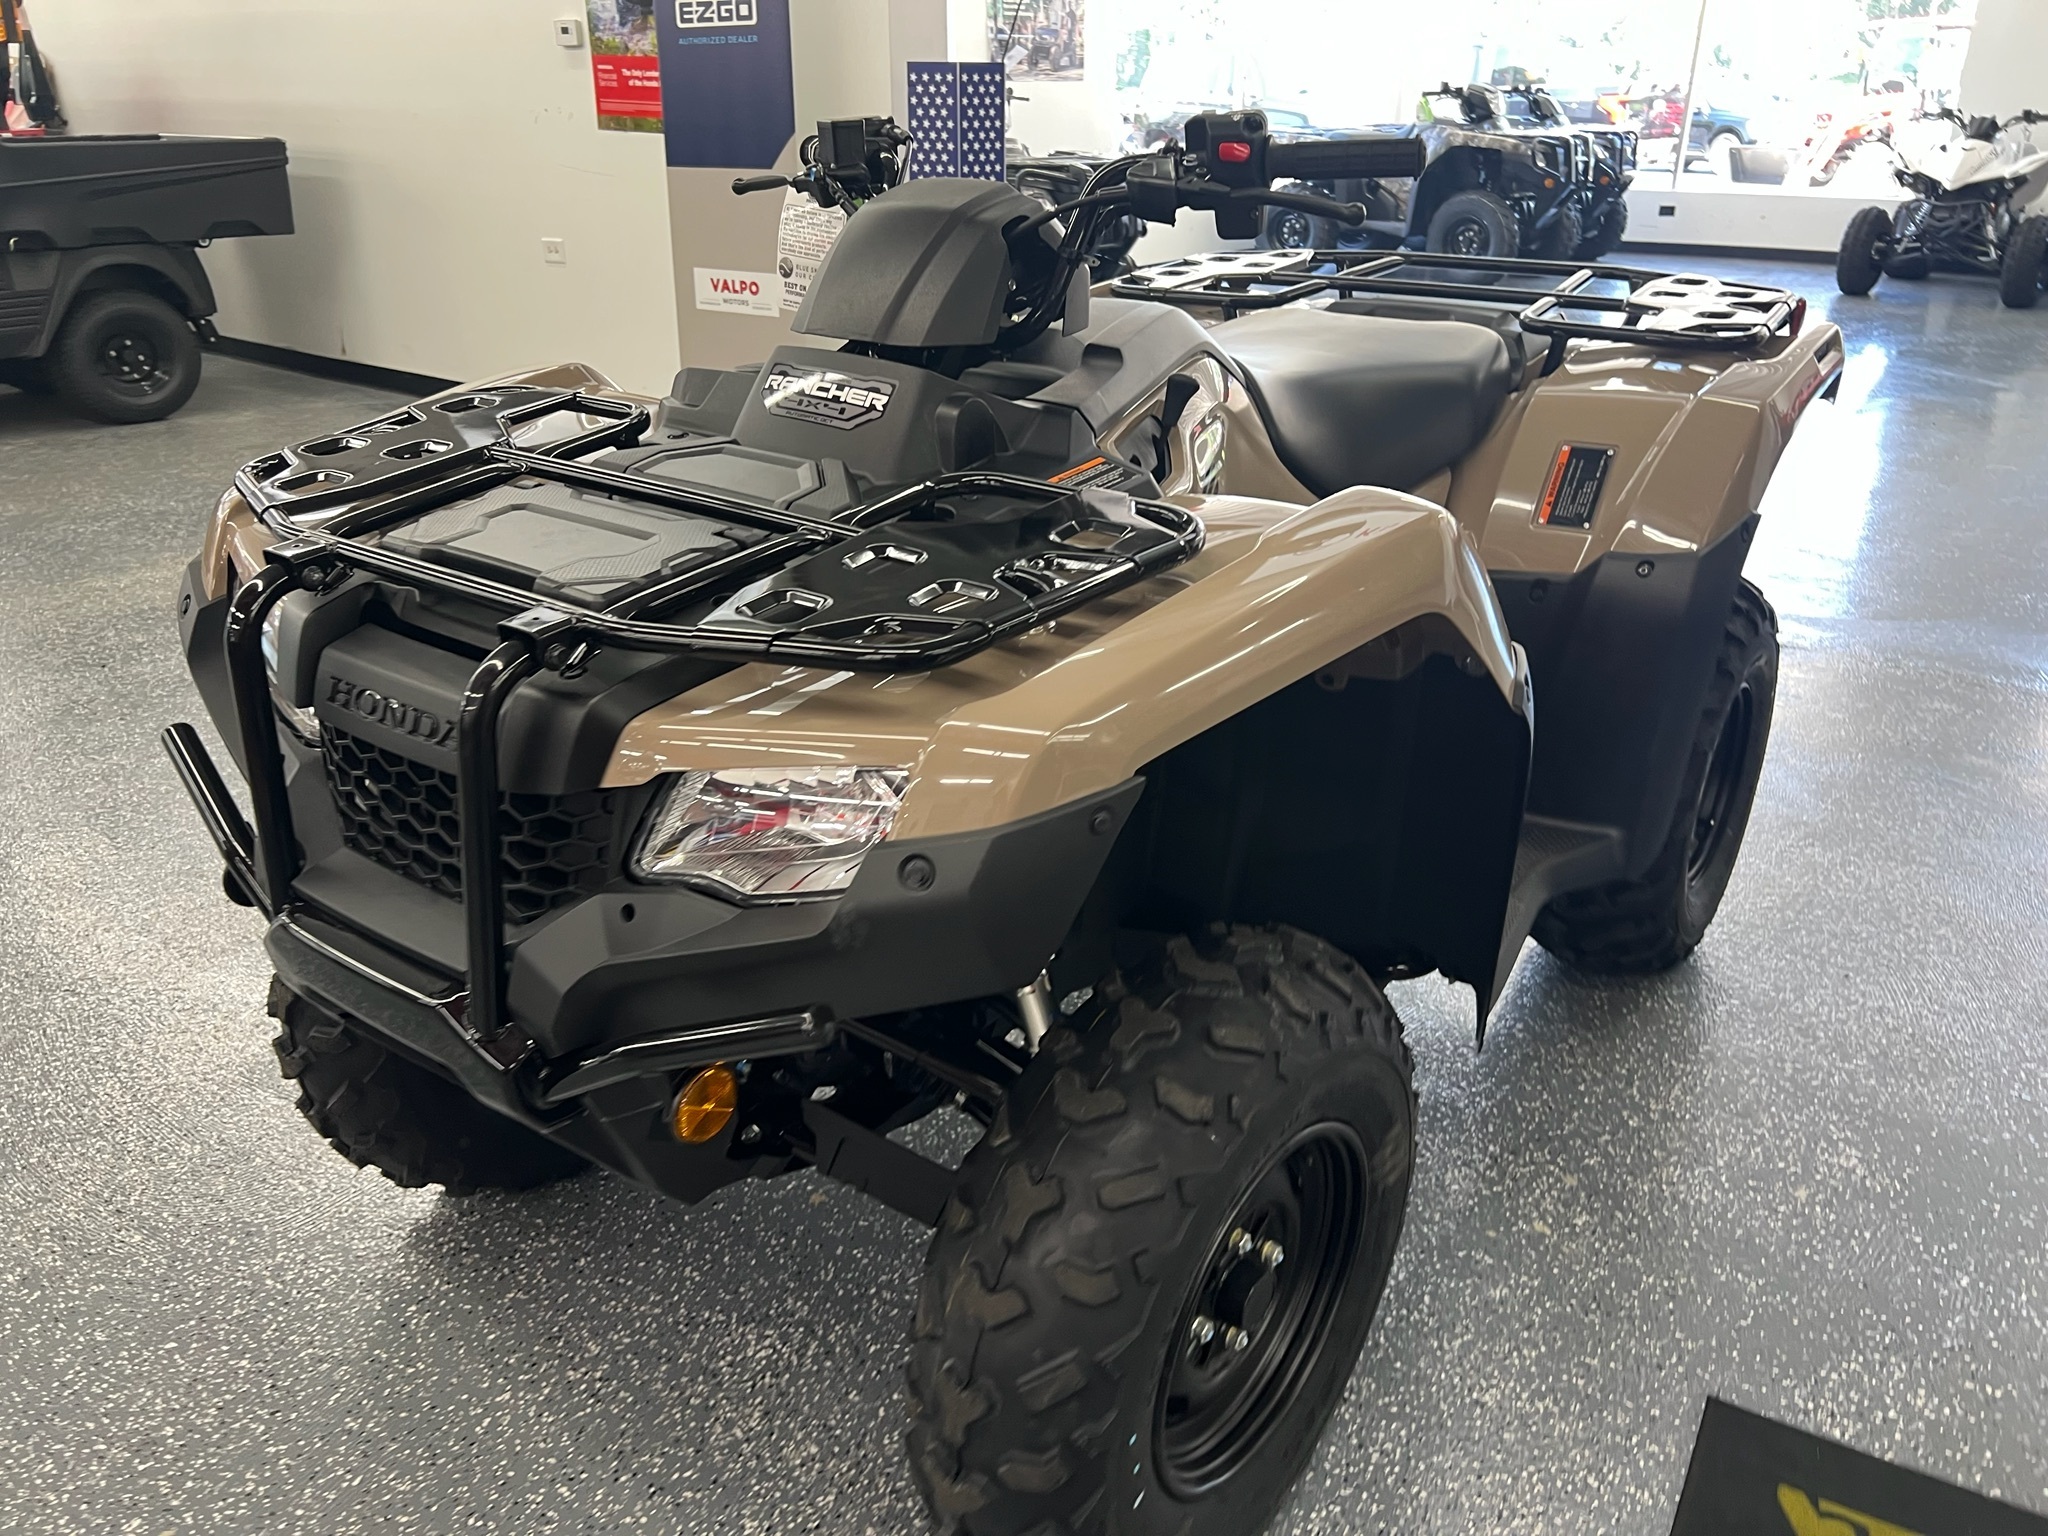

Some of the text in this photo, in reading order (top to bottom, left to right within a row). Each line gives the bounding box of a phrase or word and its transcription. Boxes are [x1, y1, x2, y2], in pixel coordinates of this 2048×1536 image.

[679, 35, 758, 45] AUTHORIZED DEALER
[710, 277, 759, 296] VALPO
[784, 281, 798, 290] BEST
[722, 298, 750, 307] MOTORS
[765, 374, 889, 411] RANCHER
[785, 410, 819, 421] AUTOMATIC
[1548, 462, 1565, 499] WARNING
